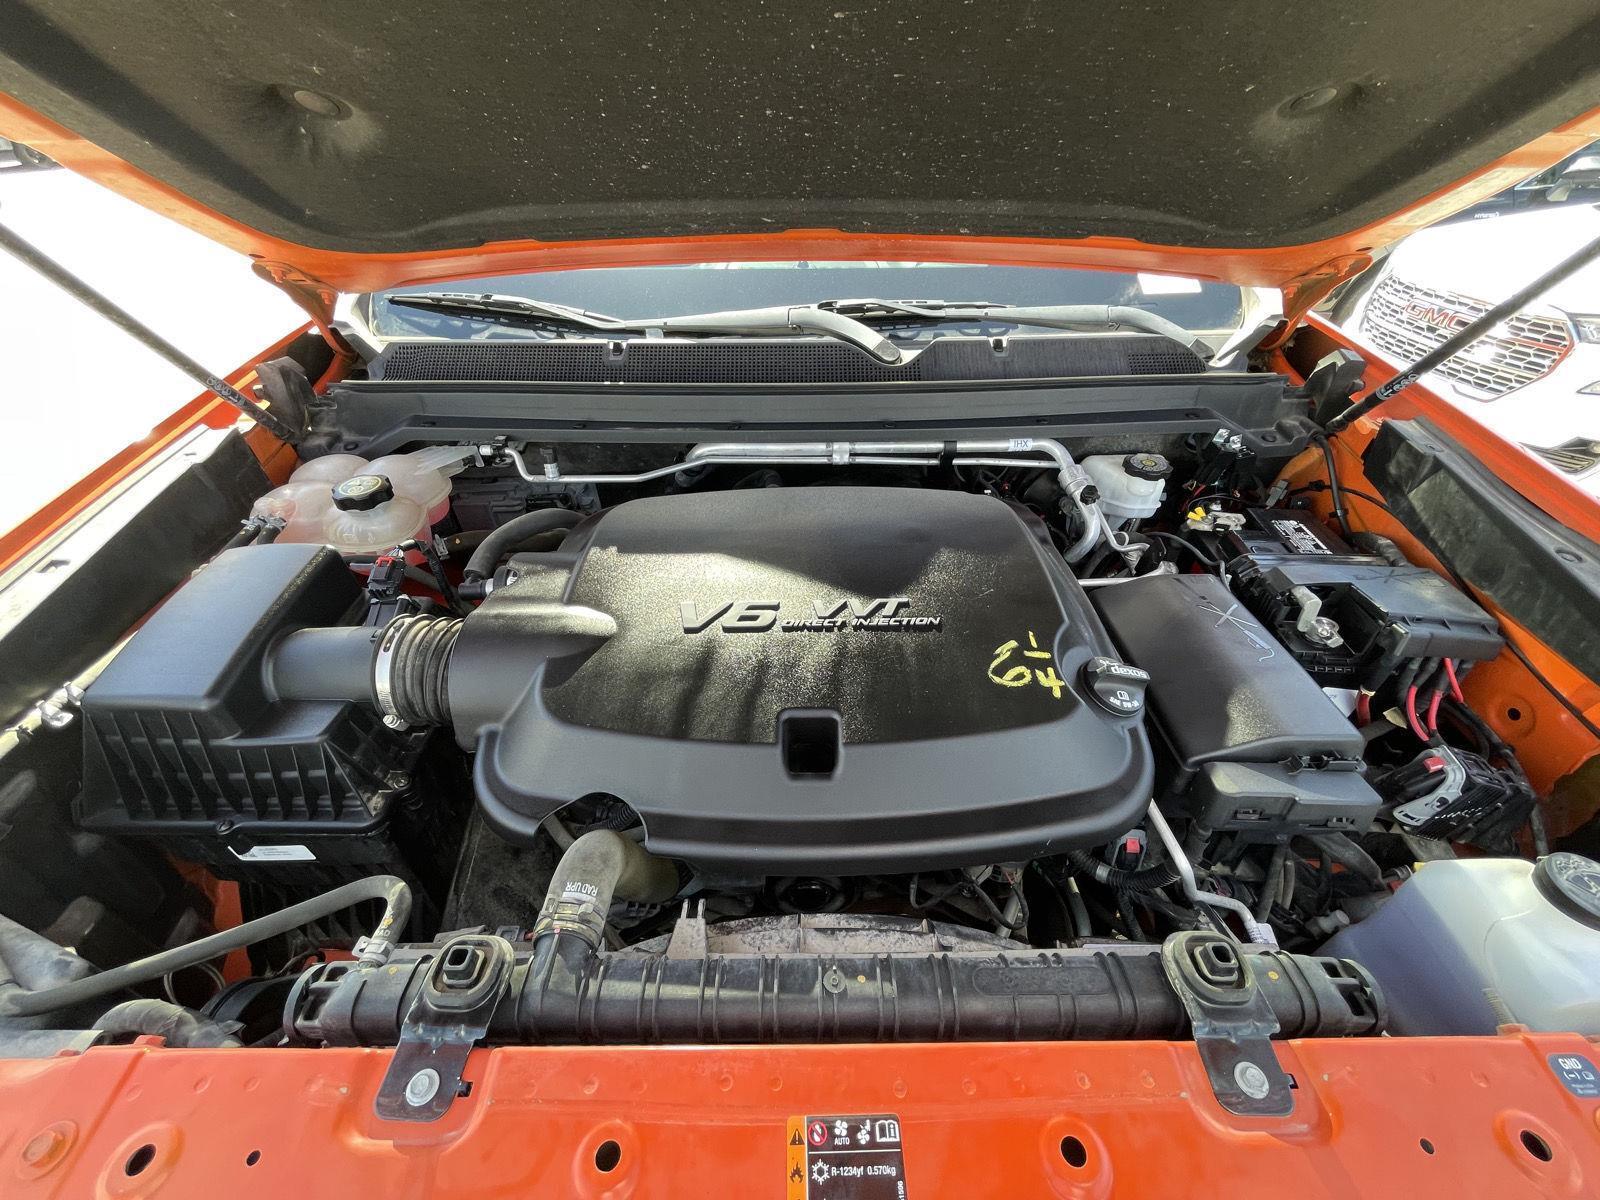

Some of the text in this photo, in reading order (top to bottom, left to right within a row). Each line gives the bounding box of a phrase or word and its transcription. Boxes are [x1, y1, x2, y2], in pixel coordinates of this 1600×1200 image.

[1405, 299, 1475, 335] GMC
[680, 597, 910, 634] V6 VVT
[781, 616, 943, 633] DIRECT INJECTION
[1110, 665, 1147, 678] dexos
[565, 881, 599, 896] RAD UPR
[834, 1137, 850, 1146] AUTO
[831, 1165, 897, 1177] R-1234yf 0.570kg
